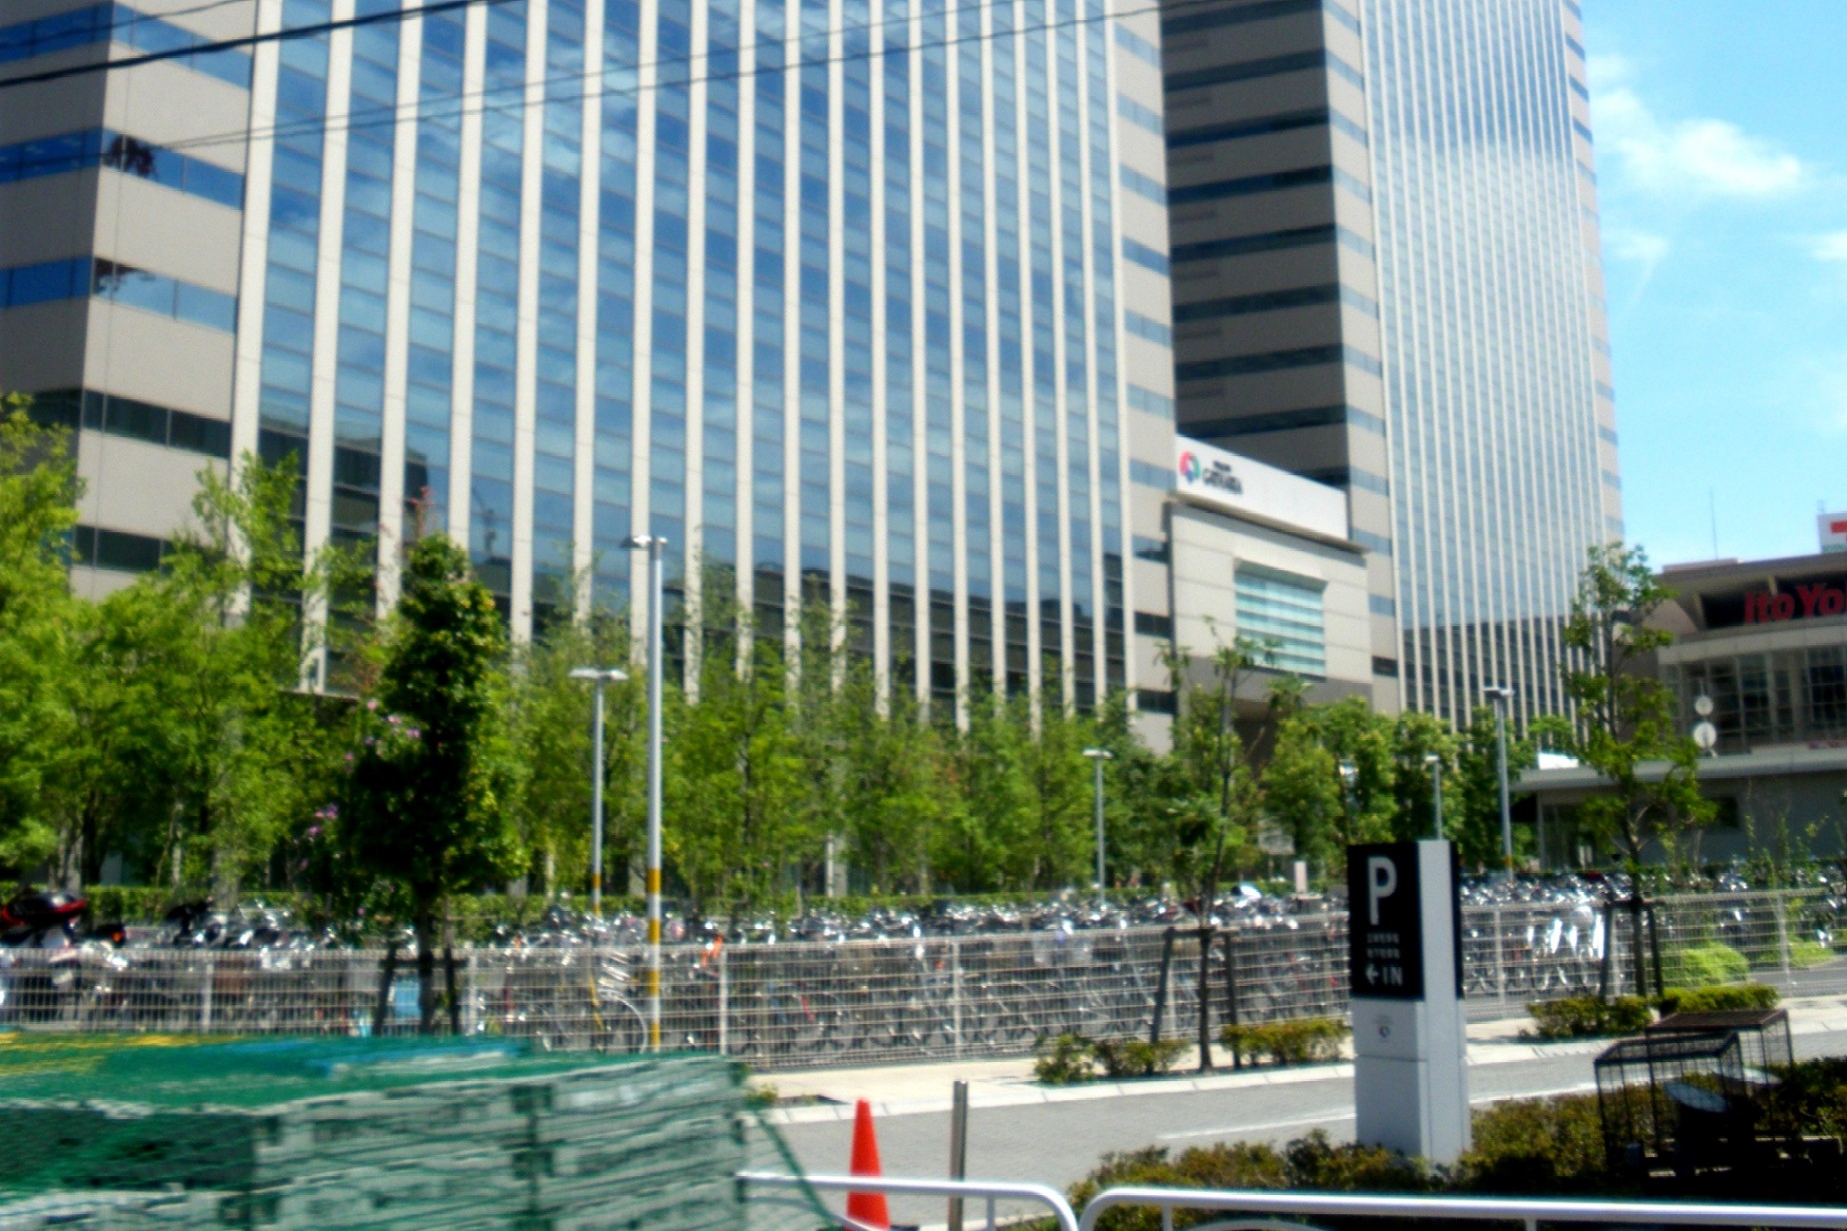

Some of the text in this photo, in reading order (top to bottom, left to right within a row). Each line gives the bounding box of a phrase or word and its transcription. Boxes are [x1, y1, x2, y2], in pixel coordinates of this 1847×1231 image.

[1796, 580, 1847, 618] Yo
[1368, 855, 1398, 926] P
[1382, 966, 1403, 985] IN
